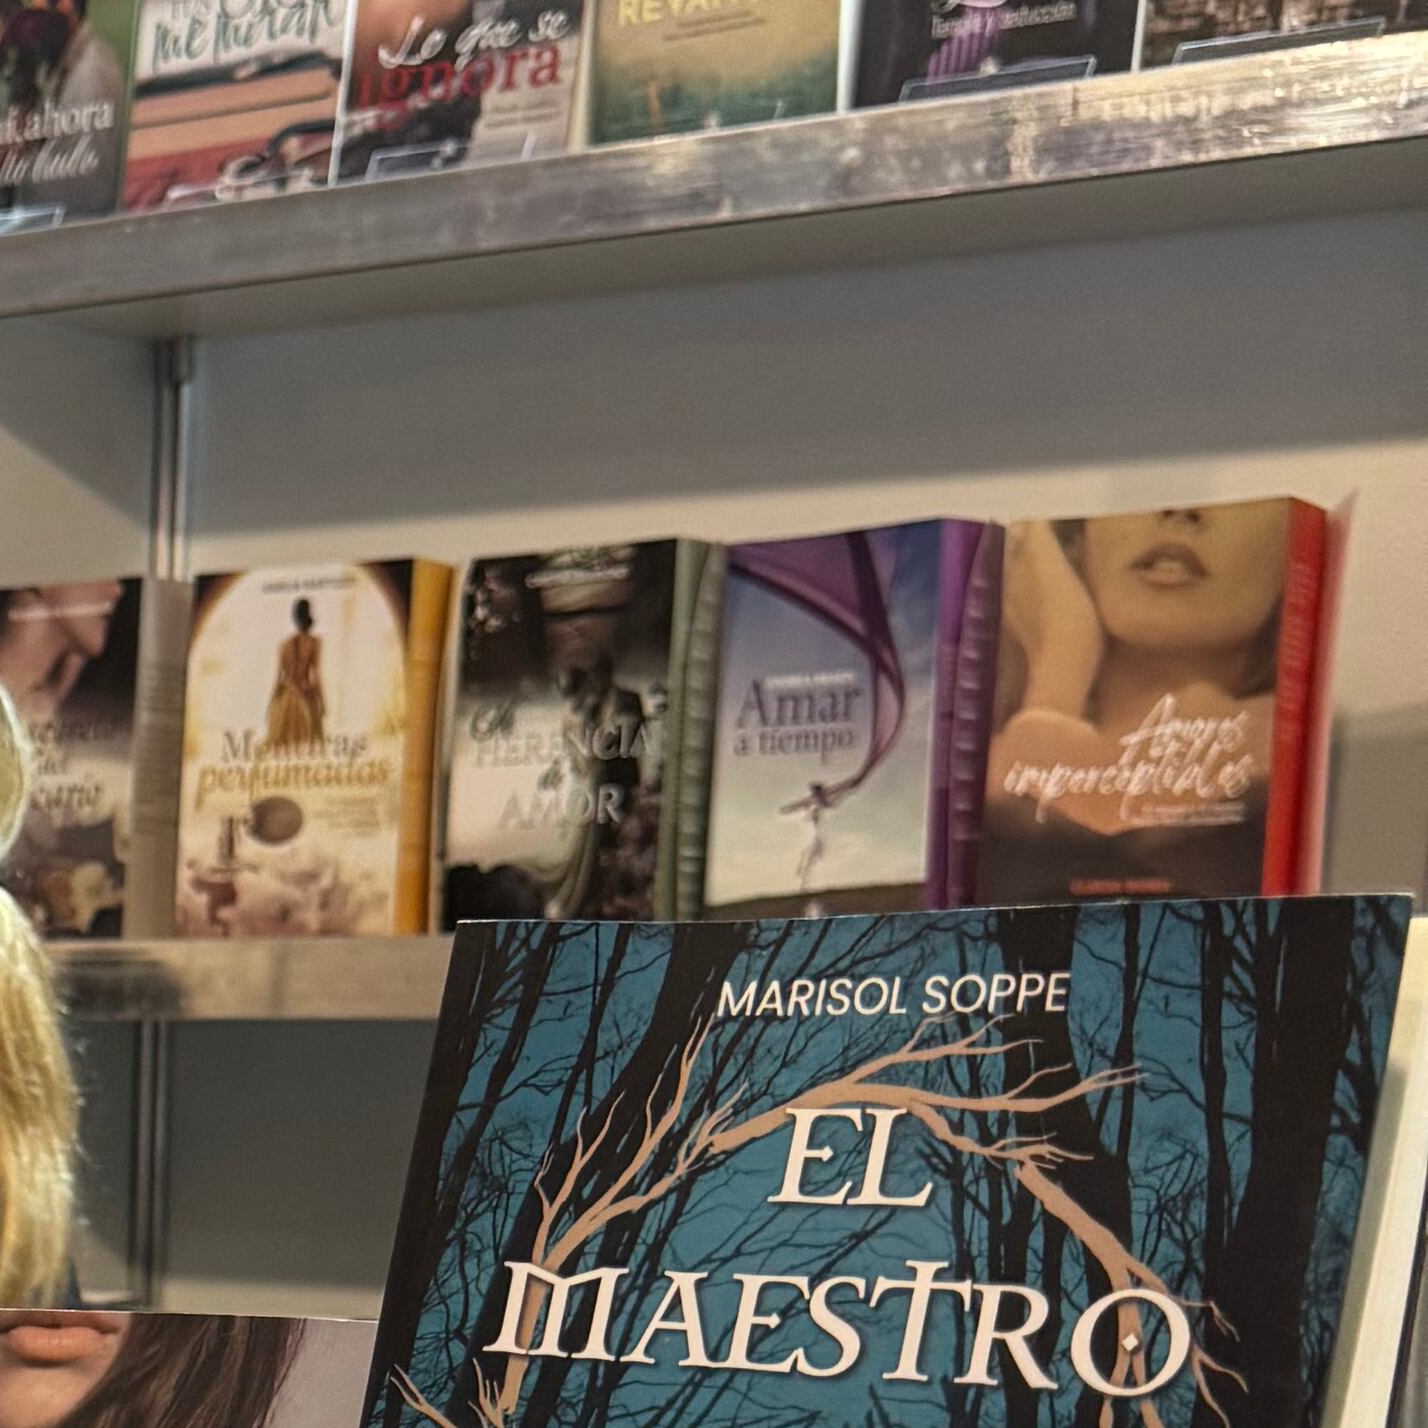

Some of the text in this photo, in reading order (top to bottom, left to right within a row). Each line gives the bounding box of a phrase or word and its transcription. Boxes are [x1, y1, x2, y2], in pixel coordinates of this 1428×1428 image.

[378, 15, 446, 69] Lo
[455, 16, 522, 72] que
[528, 9, 571, 43] se
[357, 43, 561, 130] ignora
[24, 97, 114, 141] ahora
[735, 679, 863, 727] Amar
[734, 727, 854, 765] a tiempo
[196, 748, 388, 811] perfumadas
[498, 782, 624, 830] AMOR
[715, 971, 1072, 1019] MARISOL SOPPE
[766, 1106, 933, 1209] EL
[482, 1258, 1192, 1398] MAESTRO
